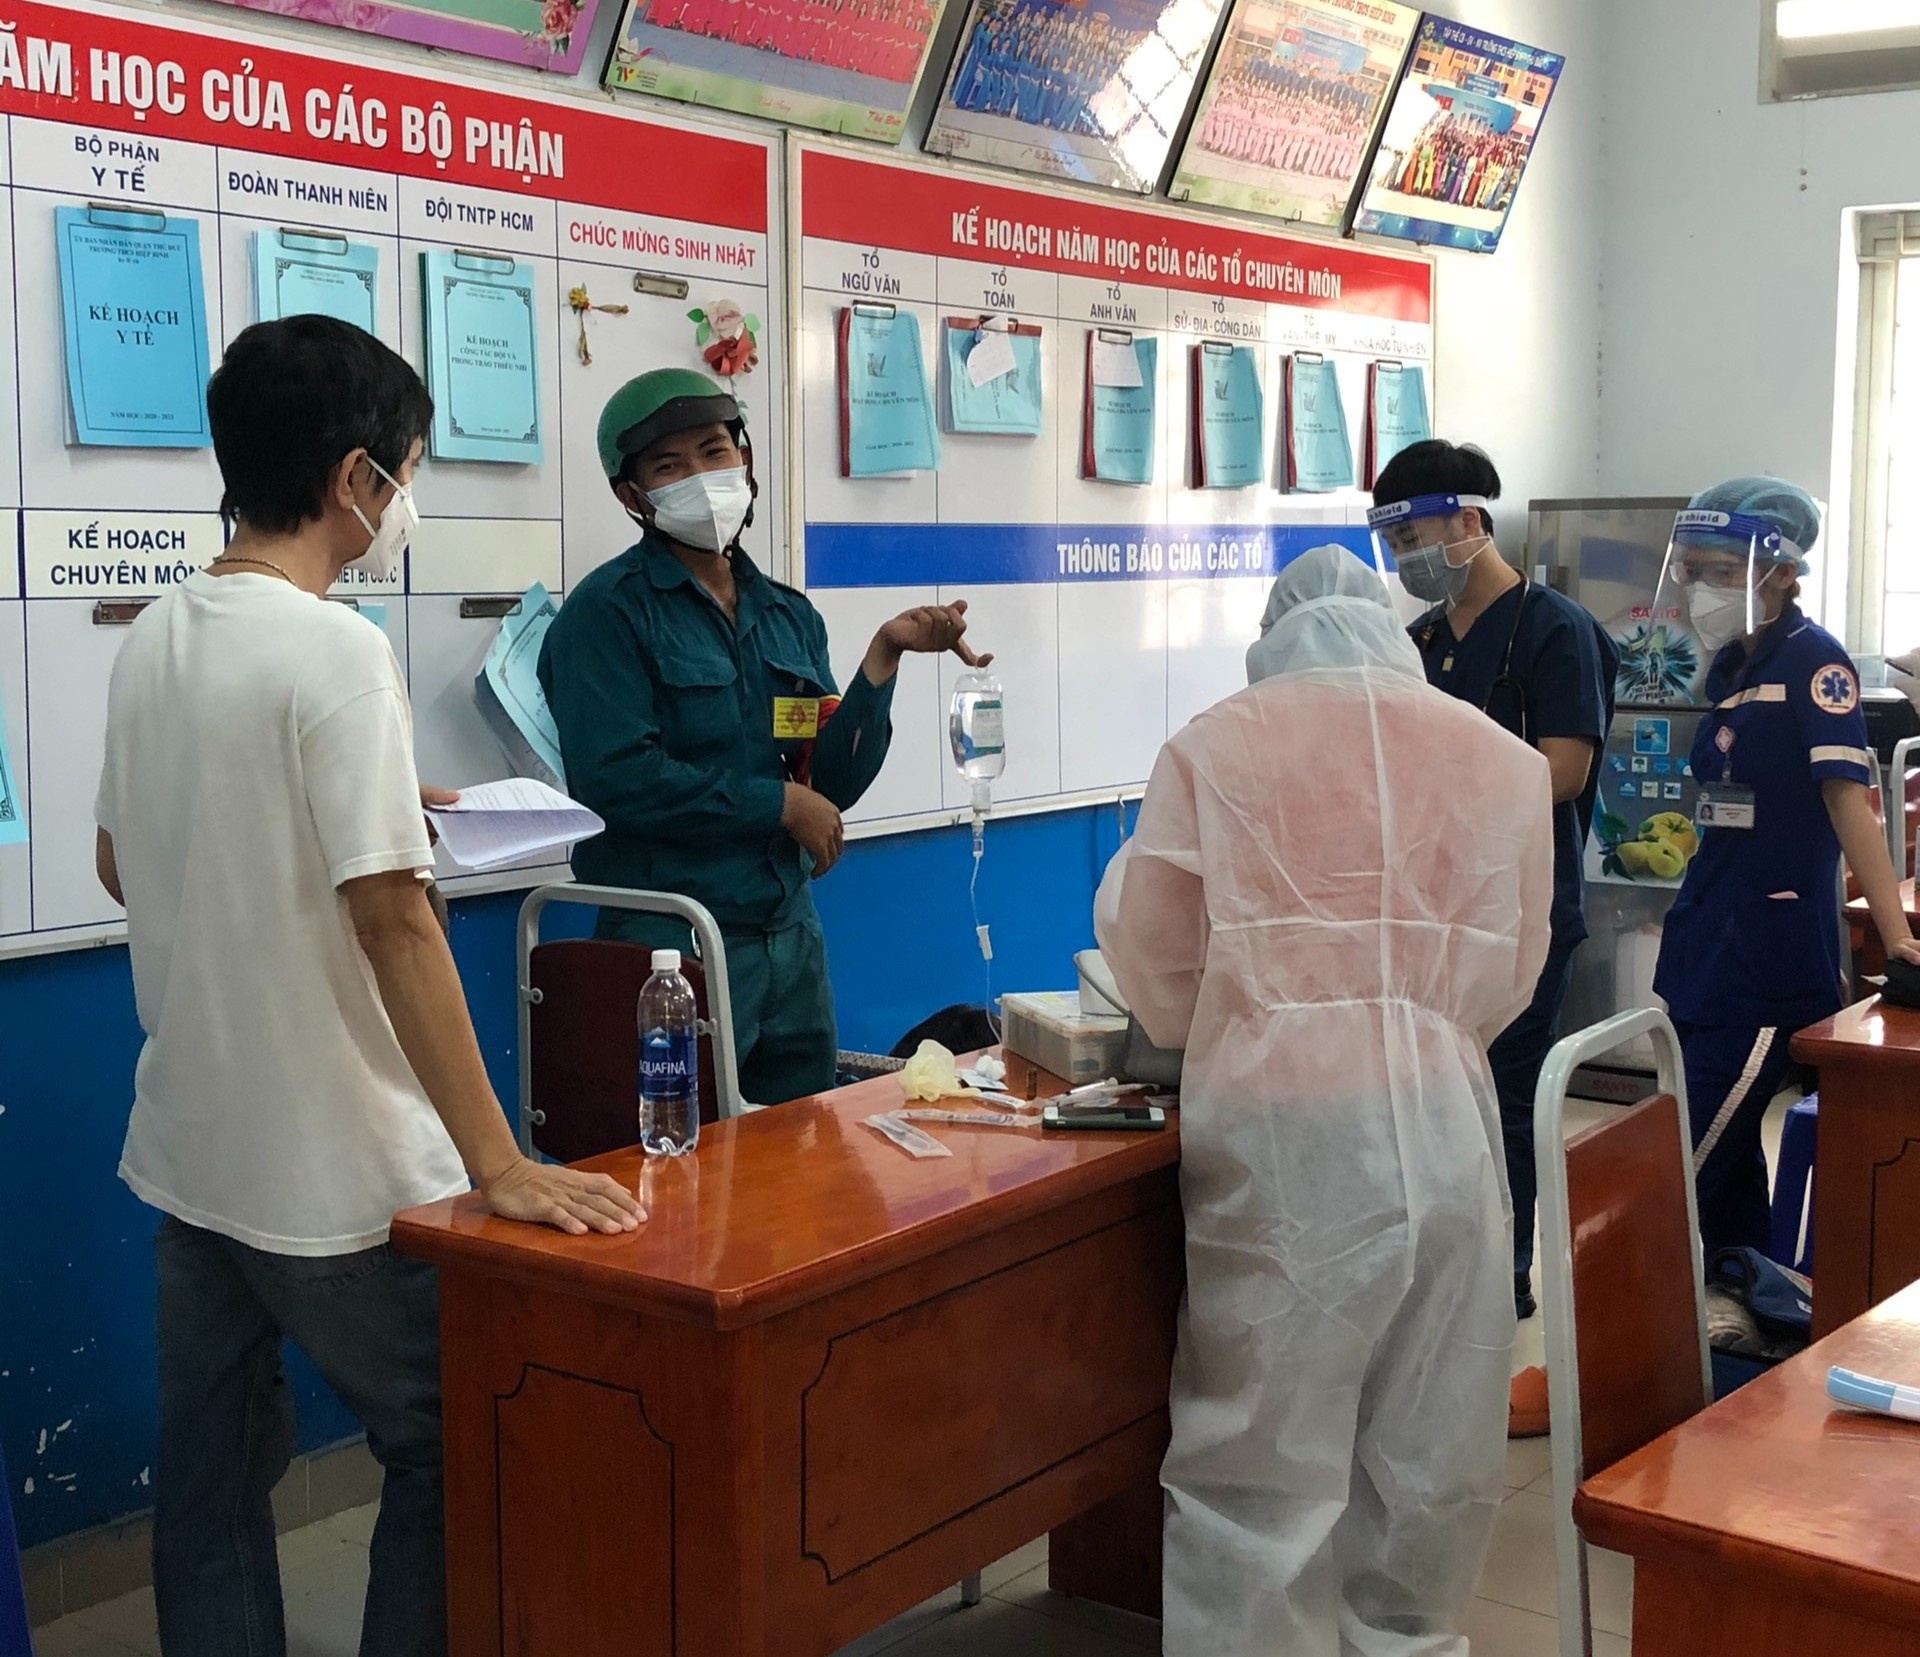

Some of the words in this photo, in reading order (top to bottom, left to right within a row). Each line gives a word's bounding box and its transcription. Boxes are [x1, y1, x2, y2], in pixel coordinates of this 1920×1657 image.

[90, 48, 186, 121] HỌC
[202, 58, 291, 133] CỦA
[305, 84, 388, 148] CÁC
[401, 101, 452, 169] BỘ
[465, 118, 564, 183] PHẬN
[75, 135, 102, 155] BỘ
[108, 140, 160, 165] PHẬN
[91, 167, 107, 186] Y
[115, 164, 146, 192] TẾ
[228, 170, 279, 197] ĐOÀN
[283, 180, 344, 206] THANH
[348, 187, 387, 212] NIÊN
[425, 197, 452, 224] ĐỘI
[456, 204, 496, 226] TNTP
[501, 210, 534, 232] HCM
[570, 220, 617, 249] CHÚC
[622, 228, 669, 257] MỪNG
[675, 237, 711, 261] SINH
[716, 242, 755, 270] NHẬT
[952, 205, 980, 246] KẾ
[985, 217, 1050, 259] HOẠCH
[1057, 225, 1099, 265] NĂM
[1105, 237, 1140, 276] HỌC
[1146, 237, 1181, 277] CỦA
[1185, 243, 1217, 282] CÁC
[1222, 248, 1242, 286] TỔ
[1246, 261, 1302, 295] CHUYÊN
[1308, 267, 1341, 300] MÔN
[862, 247, 880, 269] TỔ
[842, 271, 871, 292] NGỮ
[875, 274, 900, 295] VĂN
[991, 266, 1008, 287] TỔ
[984, 287, 1015, 309] TOÁN
[1106, 281, 1121, 301] TỔ
[89, 302, 112, 321] KẾ
[117, 308, 179, 328] HOẠCH
[1090, 303, 1112, 320] ANH
[1115, 302, 1136, 323] VĂN
[1212, 296, 1225, 314] TỔ
[117, 330, 127, 344] Y
[1242, 317, 1261, 339] DÂN
[1685, 513, 1719, 523] shield
[68, 521, 100, 549] KẾ
[107, 529, 186, 553] HOẠCH
[1057, 537, 1120, 574] THÔNG
[1127, 539, 1163, 573] BÁO
[1168, 533, 1201, 572] CỦA
[1207, 537, 1239, 571] CÁC
[1243, 531, 1264, 570] TỔ
[51, 561, 142, 585] CHUYÊN
[639, 1060, 687, 1077] AQUAFINA
